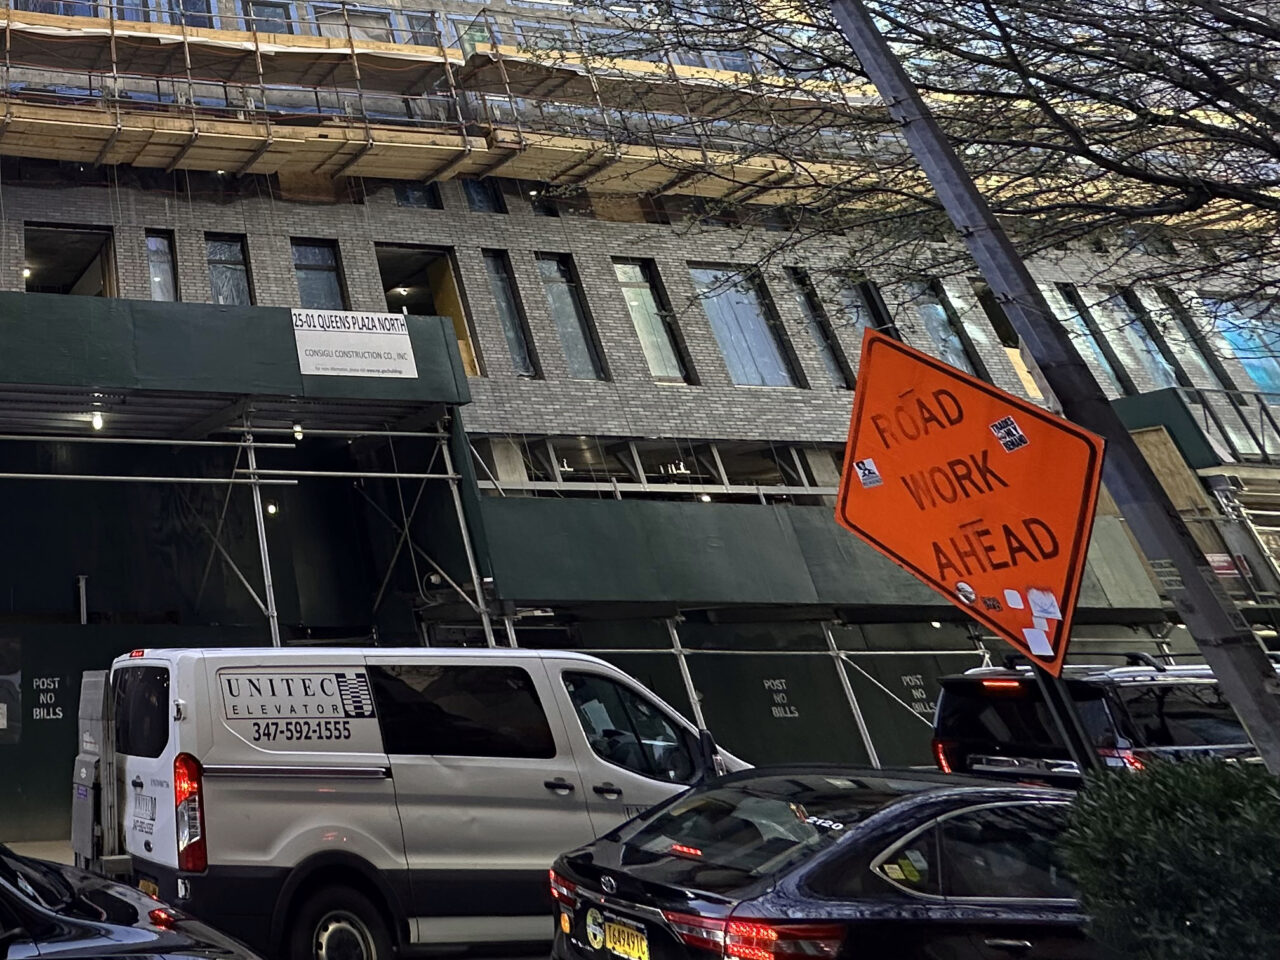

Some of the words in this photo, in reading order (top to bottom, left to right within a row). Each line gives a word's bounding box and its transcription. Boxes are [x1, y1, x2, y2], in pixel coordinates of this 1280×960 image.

[293, 313, 317, 328] 25-01
[317, 314, 351, 331] QUEENS
[352, 316, 378, 331] PLAZA
[378, 317, 408, 332] NORTH
[304, 348, 334, 358] CONSIGLI
[334, 349, 383, 359] CONSTRUCTION
[870, 388, 964, 450] ROAD
[900, 449, 1010, 511] WORK
[931, 517, 1060, 582] AHEAD
[33, 677, 60, 690] POST
[763, 679, 787, 690] POST
[901, 675, 923, 686] POST
[226, 678, 335, 698] UNITEC
[911, 688, 927, 699] NO
[39, 692, 55, 704] NO
[773, 692, 787, 704] NO
[33, 706, 63, 720] BILLS
[232, 704, 340, 715] ELEVATOR
[772, 706, 799, 718] BILLS
[911, 701, 936, 713] BILLS
[252, 720, 352, 742] 347-592-1555
